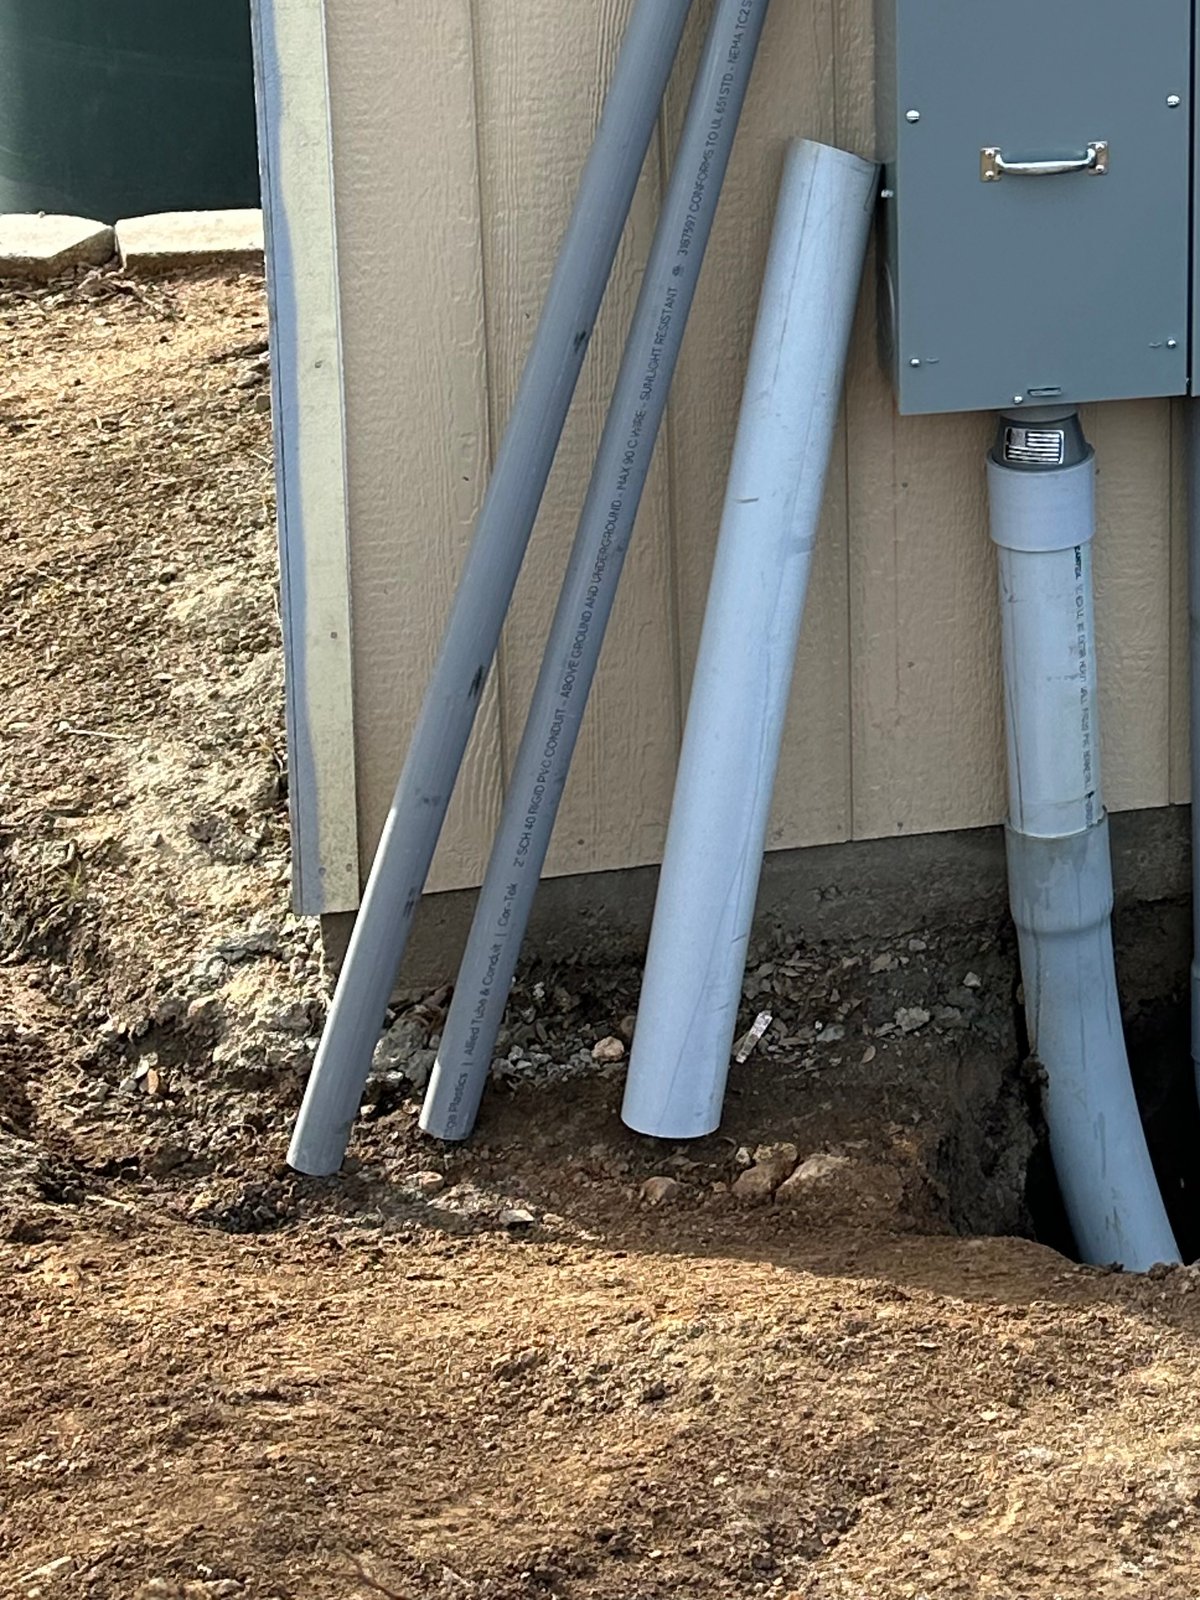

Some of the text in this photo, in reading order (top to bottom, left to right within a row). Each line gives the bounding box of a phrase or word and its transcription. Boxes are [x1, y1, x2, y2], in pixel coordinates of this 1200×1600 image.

[726, 31, 744, 65] NEMA
[718, 71, 734, 96] STD
[713, 94, 728, 114] 651
[709, 114, 723, 131] UL
[705, 130, 719, 149] TO
[688, 147, 715, 212] CONFORMS
[653, 285, 678, 345] RESISTANT
[638, 345, 662, 402] SUNLIGHT
[628, 408, 646, 439] WIRE
[621, 448, 635, 465] 90
[626, 437, 638, 449] C
[614, 465, 631, 492] MAX
[590, 498, 622, 584] UNDERGROUND
[583, 584, 599, 609] AND
[570, 609, 592, 659] GROUND
[559, 658, 579, 698] ABOVE
[543, 707, 566, 759] CONDUIT
[536, 758, 552, 783] PVC
[527, 783, 545, 816] RIGID
[523, 814, 537, 830] 40
[516, 830, 533, 857] SCH
[497, 881, 519, 928] Cor-Tek
[481, 942, 503, 987] Conduit
[479, 986, 491, 997] &
[471, 996, 488, 1026] Tube
[463, 1025, 480, 1056] Allied
[447, 1070, 468, 1113] Plastics
